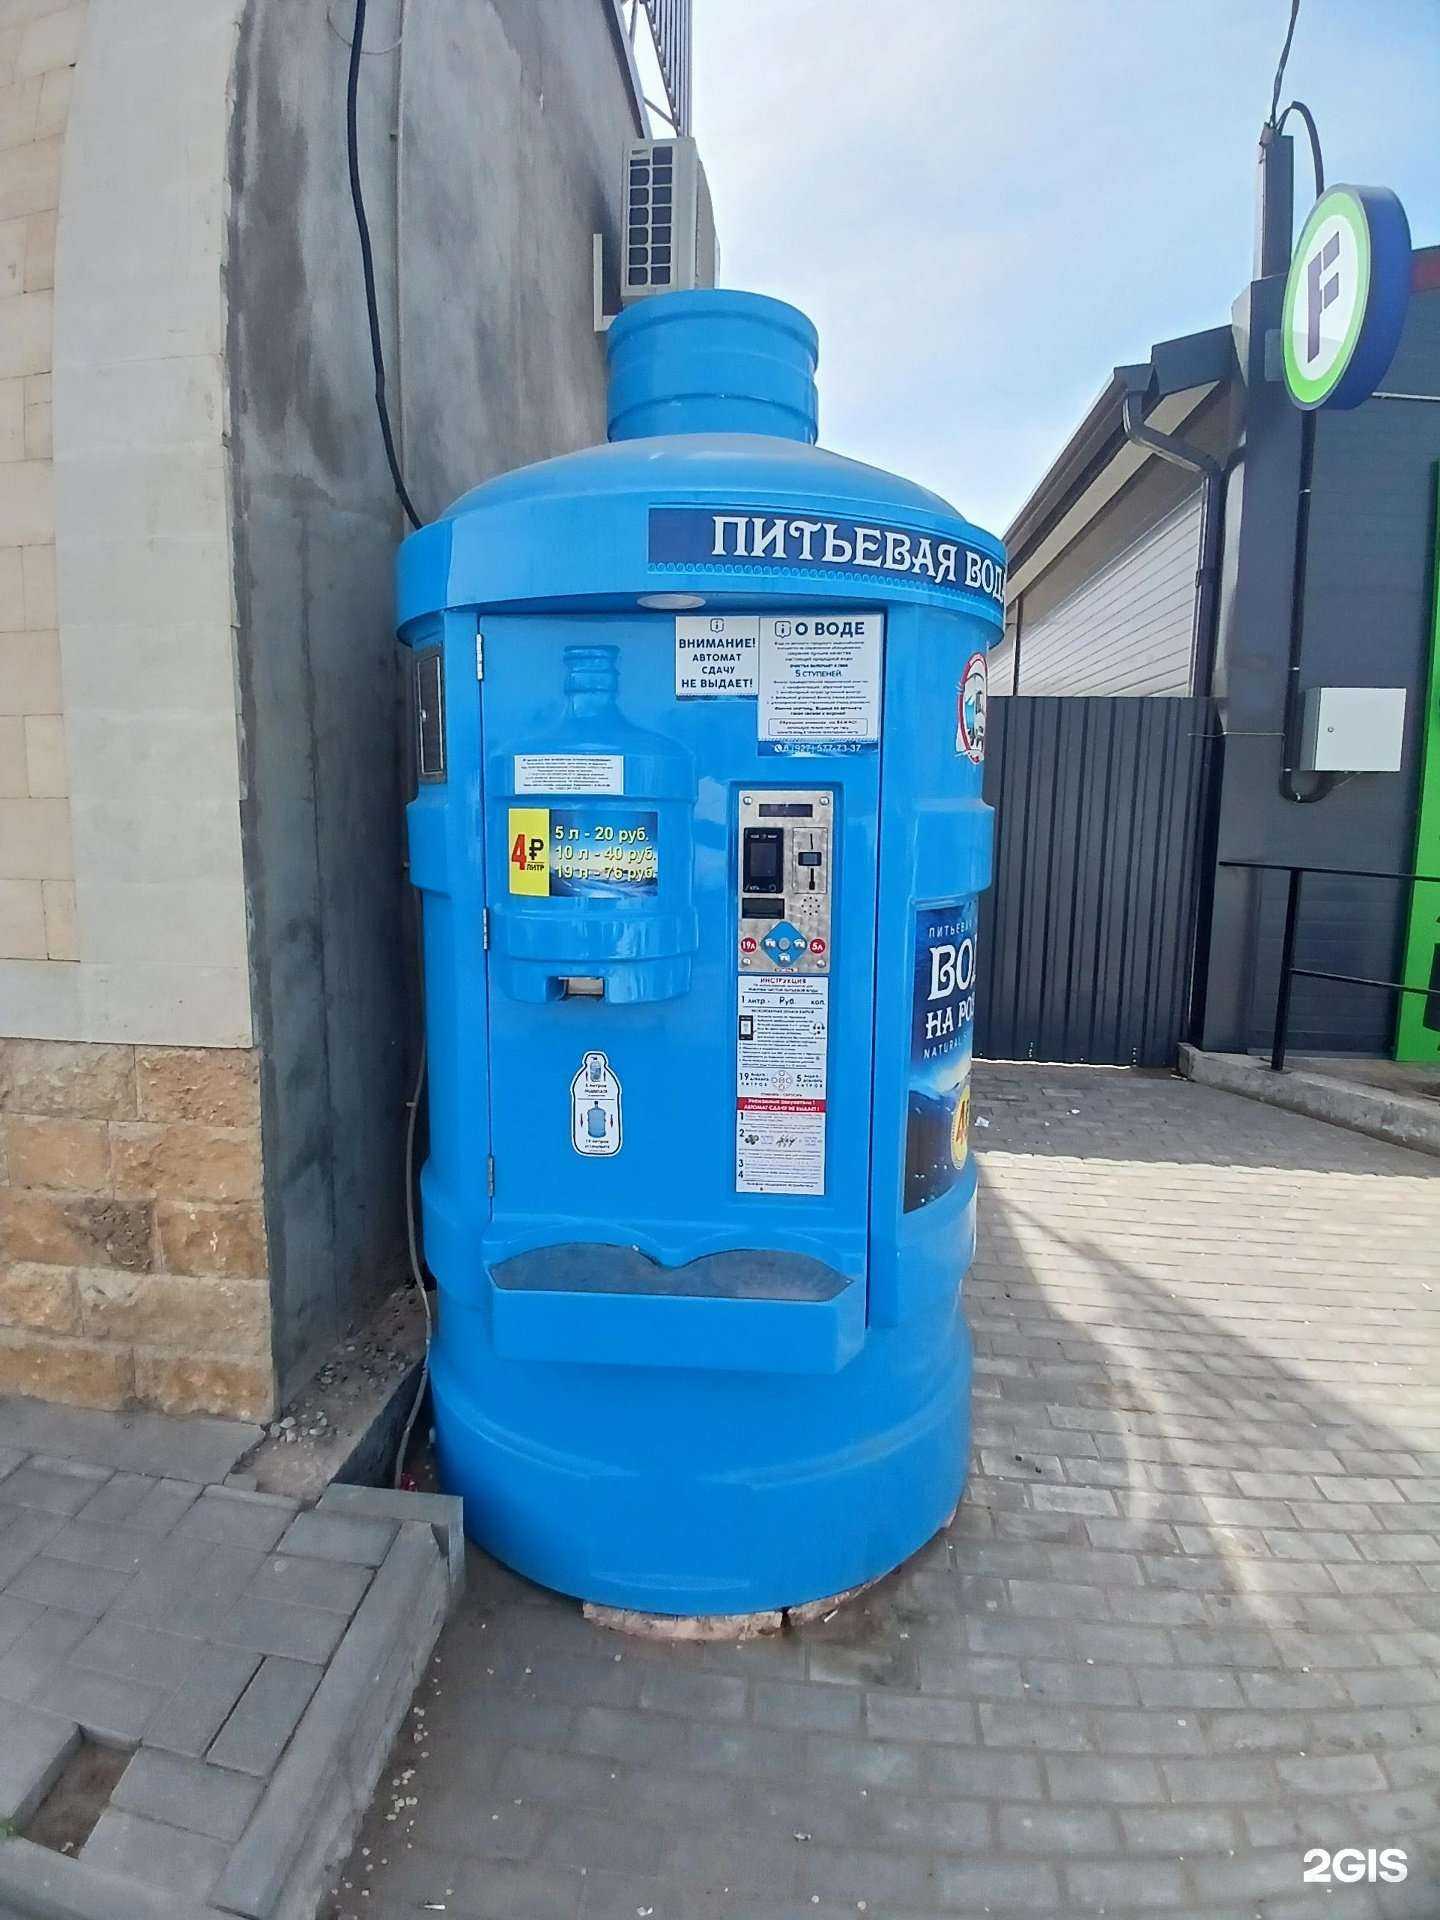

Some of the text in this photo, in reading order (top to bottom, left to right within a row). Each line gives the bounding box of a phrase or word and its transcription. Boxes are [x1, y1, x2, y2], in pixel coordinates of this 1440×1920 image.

[711, 515, 1006, 604] ПИТЬЕВАЯ ВОД
[795, 621, 865, 638] О ВОДЕ
[679, 638, 756, 649] ВНИМАНИЕ!
[692, 653, 742, 662] АВТОМАТ
[701, 666, 736, 675] СДАЧУ
[795, 669, 842, 677] 5 СТУПЕНЕЙ
[681, 678, 753, 690] НЕ ВЫДАЕТ!
[555, 826, 564, 839] 5
[568, 829, 579, 840] л
[594, 827, 614, 840] 20
[619, 827, 649, 844] руб.
[512, 834, 527, 870] 4
[556, 845, 573, 860] 10
[579, 848, 589, 860] л
[604, 846, 623, 861] 40
[628, 846, 656, 864] руб.
[555, 865, 573, 880] 19
[579, 868, 589, 879] л
[604, 867, 624, 880] 76
[627, 866, 656, 882] руб.
[929, 919, 972, 938] ПИТЬЕВ
[926, 1007, 954, 1040] НА
[739, 1128, 745, 1138] 2
[738, 1159, 744, 1168] 3
